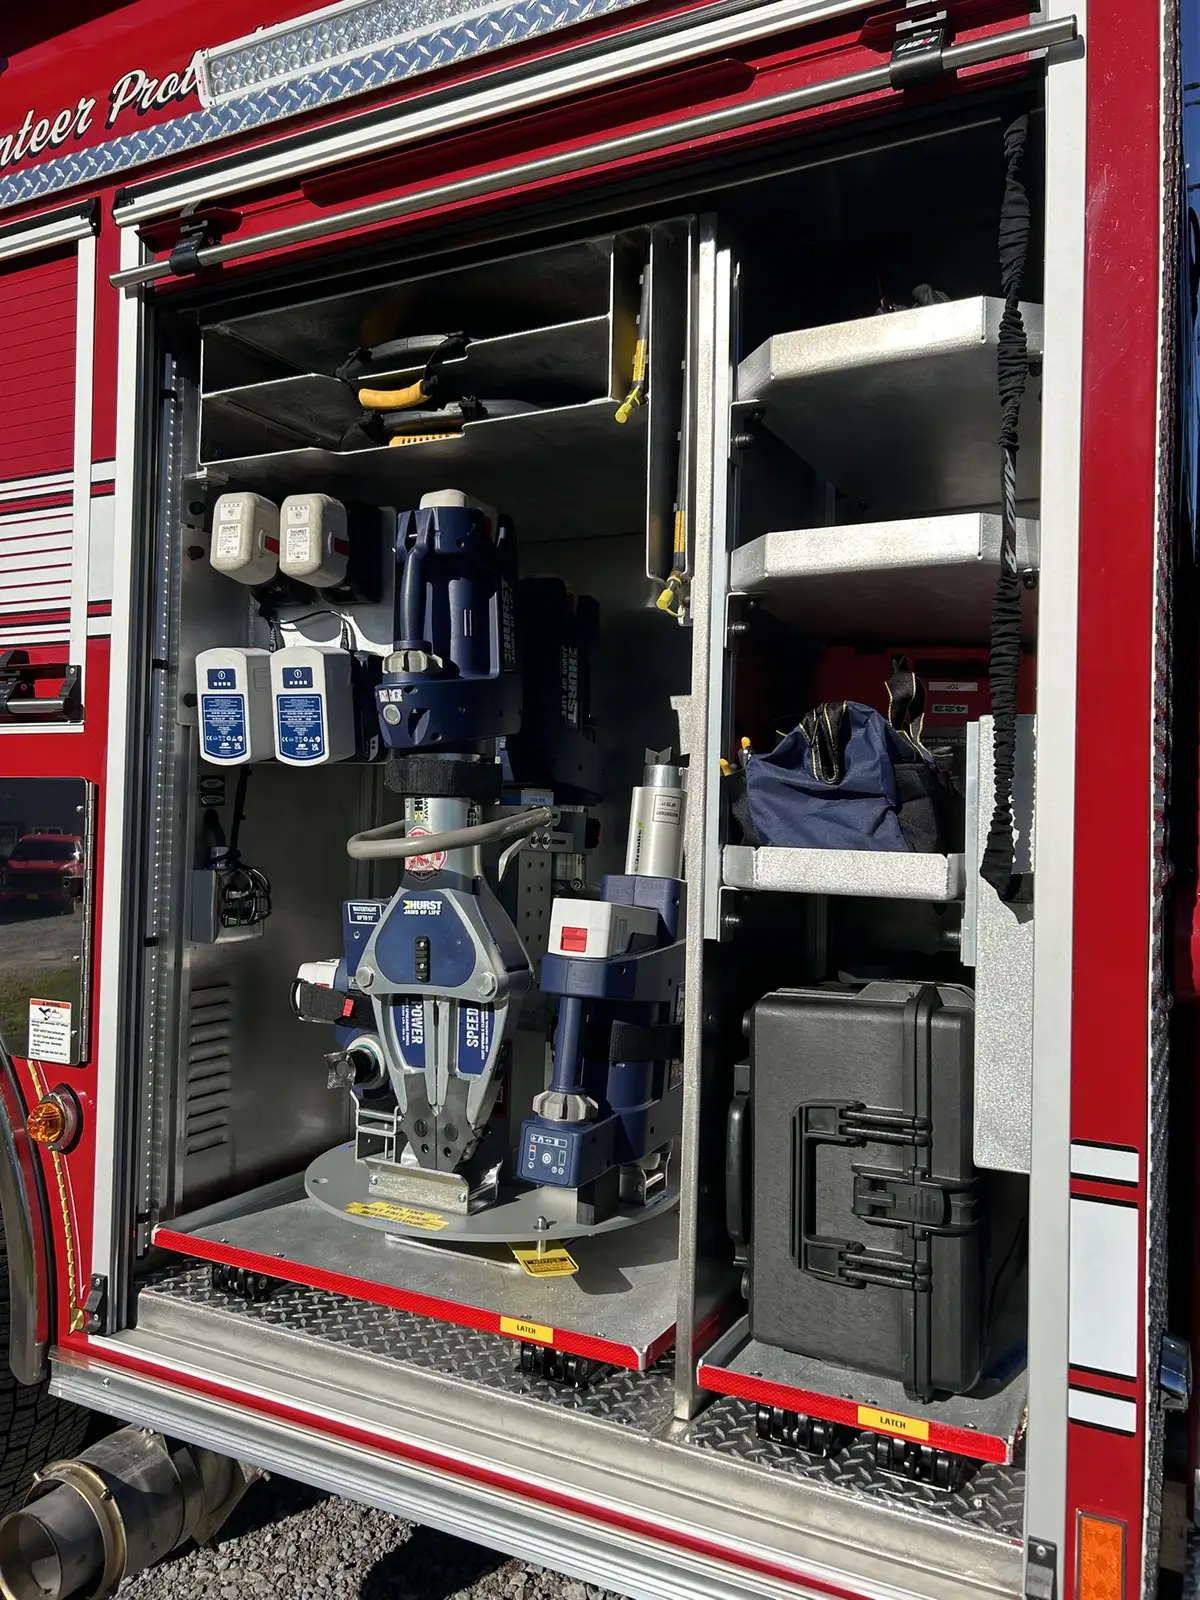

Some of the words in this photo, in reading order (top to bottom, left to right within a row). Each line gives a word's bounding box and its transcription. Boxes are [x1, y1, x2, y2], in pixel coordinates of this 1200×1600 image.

[410, 900, 442, 910] HURST
[411, 1000, 424, 1045] POWER
[466, 1008, 479, 1048] SPEED
[516, 1324, 536, 1335] LATCH
[880, 1416, 906, 1429] LATCH
